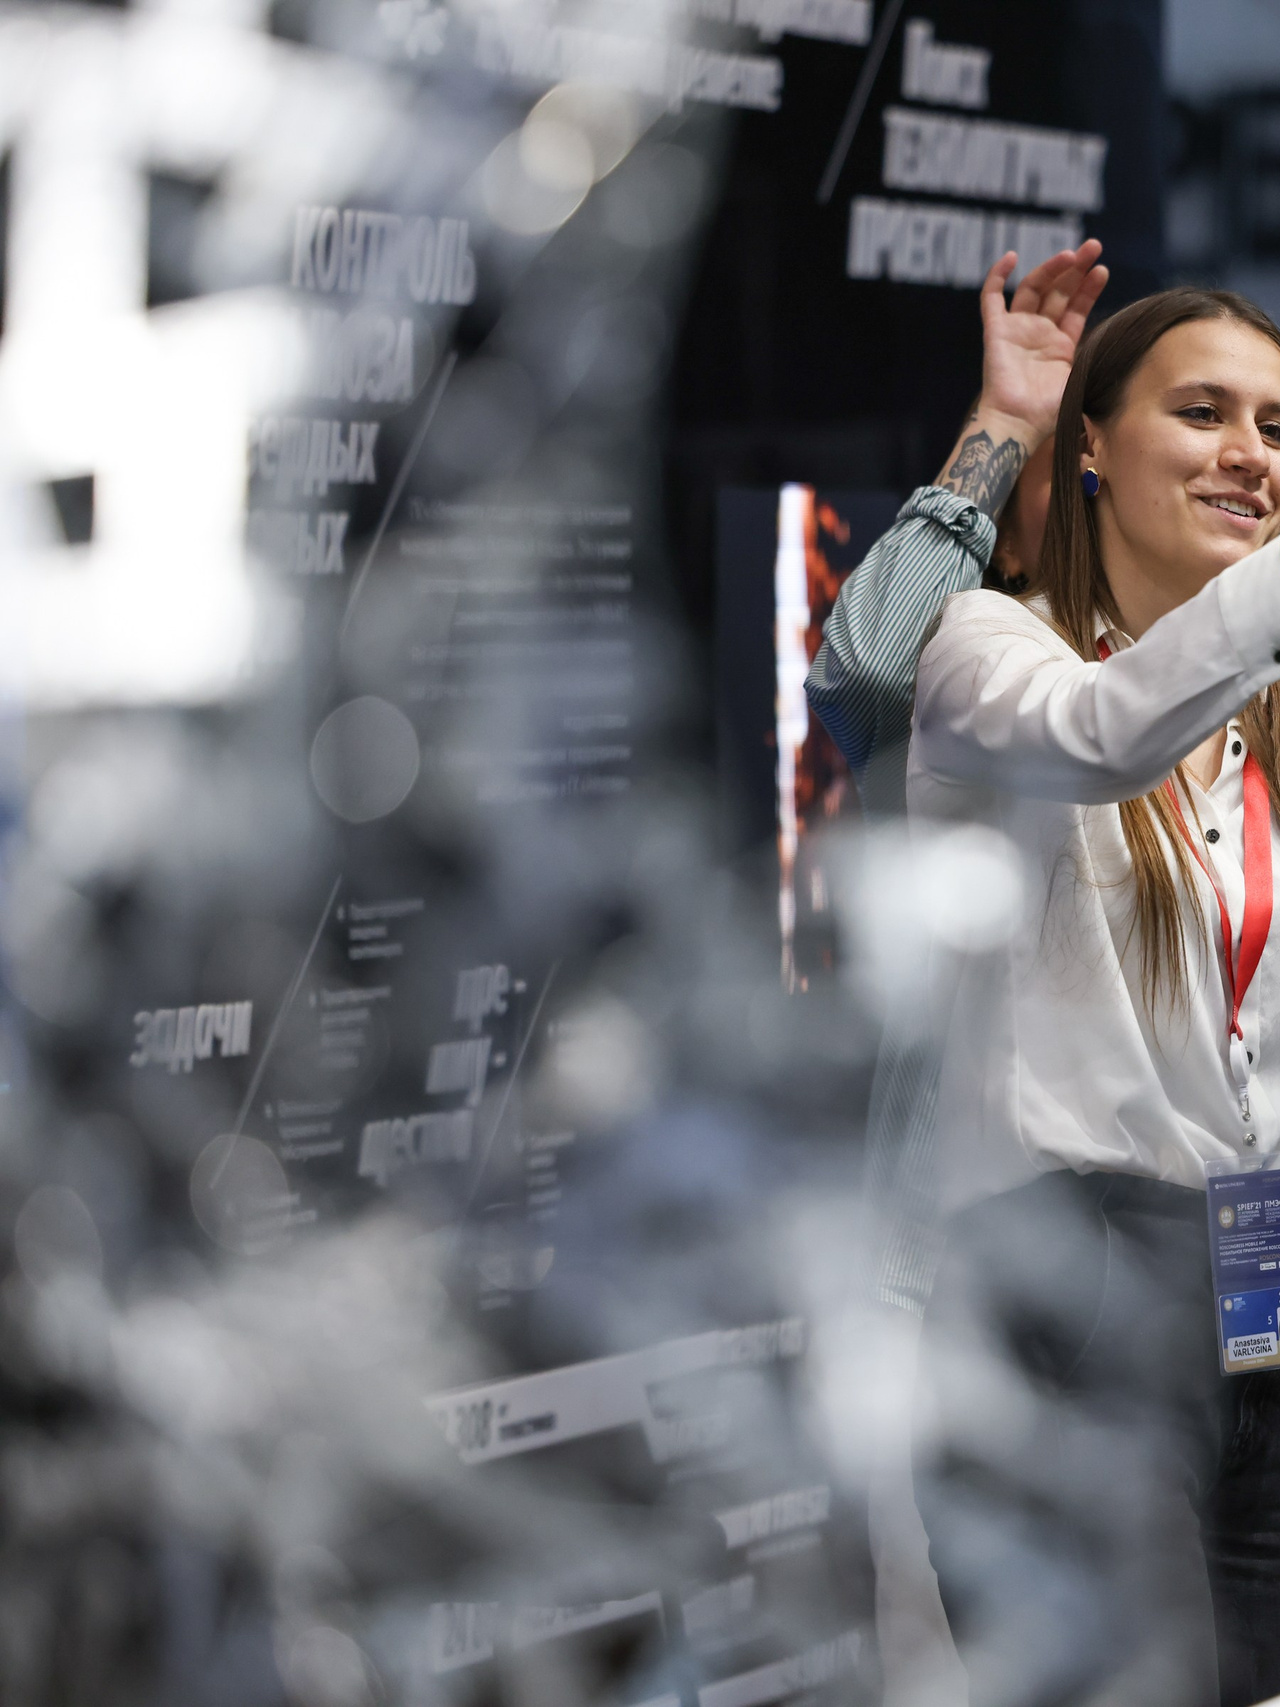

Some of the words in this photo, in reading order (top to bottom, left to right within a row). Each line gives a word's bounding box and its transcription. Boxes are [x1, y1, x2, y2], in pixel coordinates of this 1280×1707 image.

[1237, 1201, 1261, 1211] SPIEF'21
[1267, 1315, 1273, 1325] 5
[1234, 1336, 1270, 1348] Anastasiya
[1232, 1344, 1273, 1358] VARLYGINA
